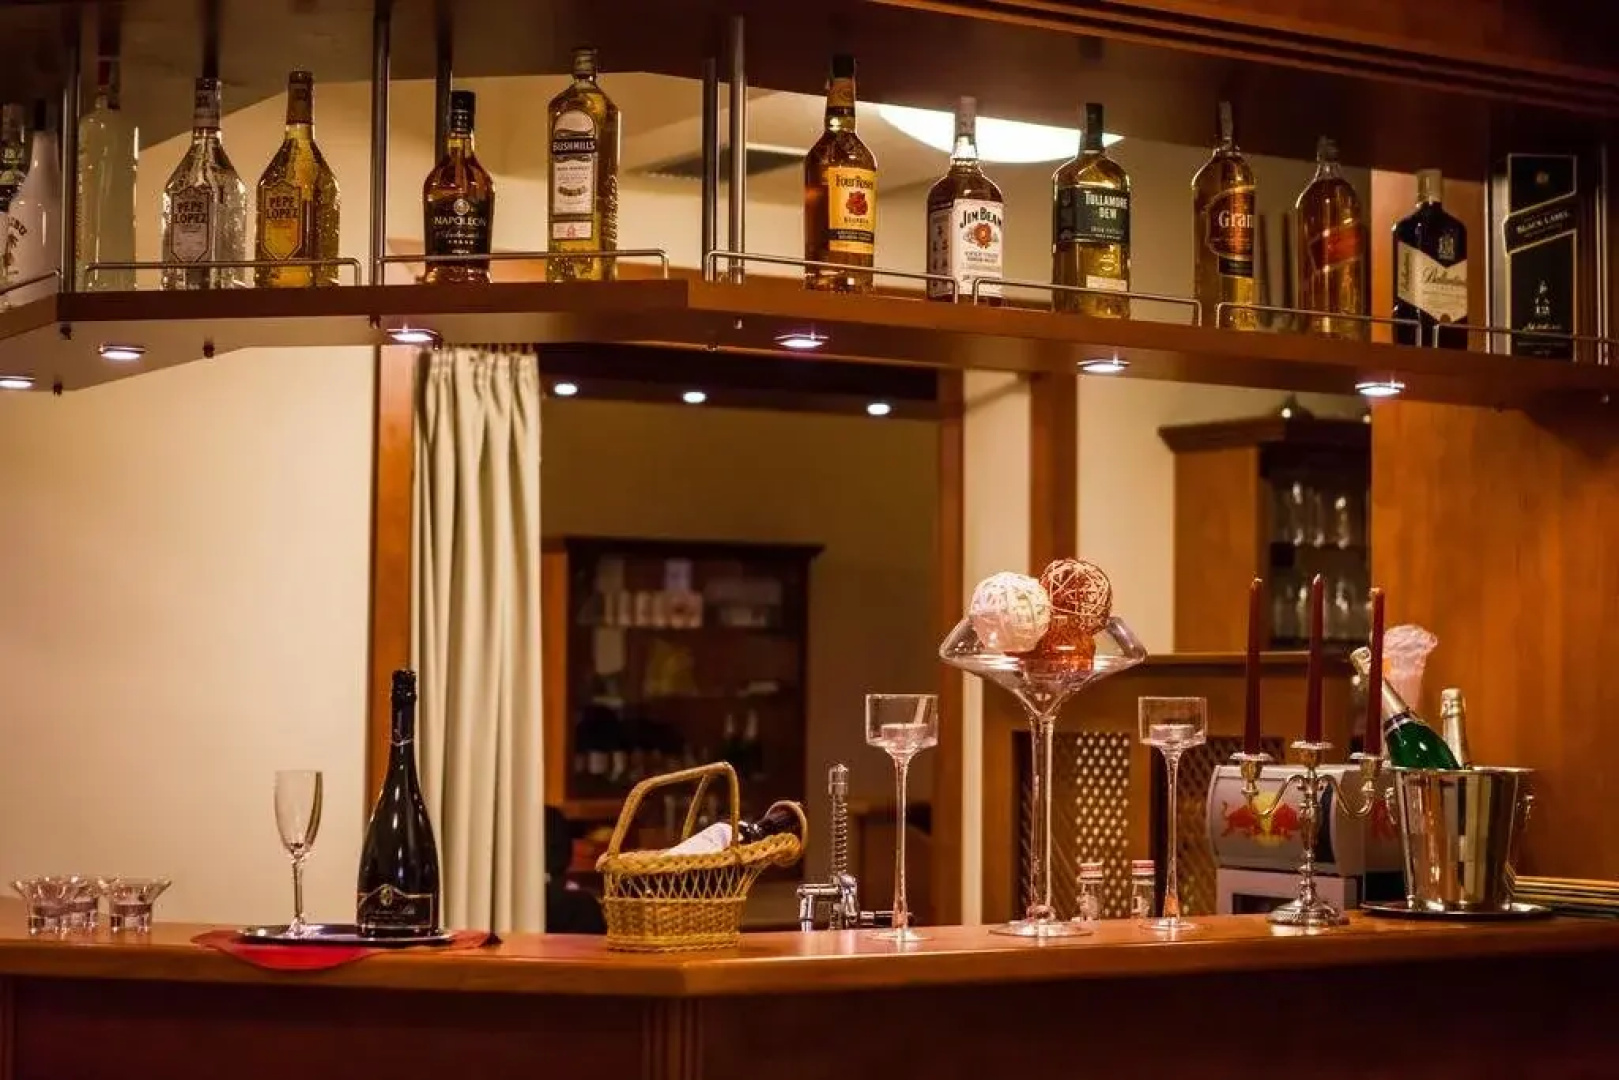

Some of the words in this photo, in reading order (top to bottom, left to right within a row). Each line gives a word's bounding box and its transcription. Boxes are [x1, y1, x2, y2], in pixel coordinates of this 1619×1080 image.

[553, 140, 595, 151] BUSHMILLS
[268, 195, 295, 208] PEPE
[1085, 189, 1128, 210] TULLAMORE
[176, 201, 204, 213] PEPE
[265, 207, 299, 219] LOPEZ
[173, 212, 206, 224] LOPEZ
[433, 216, 487, 227] NAPOLEON
[959, 210, 978, 229] JIM
